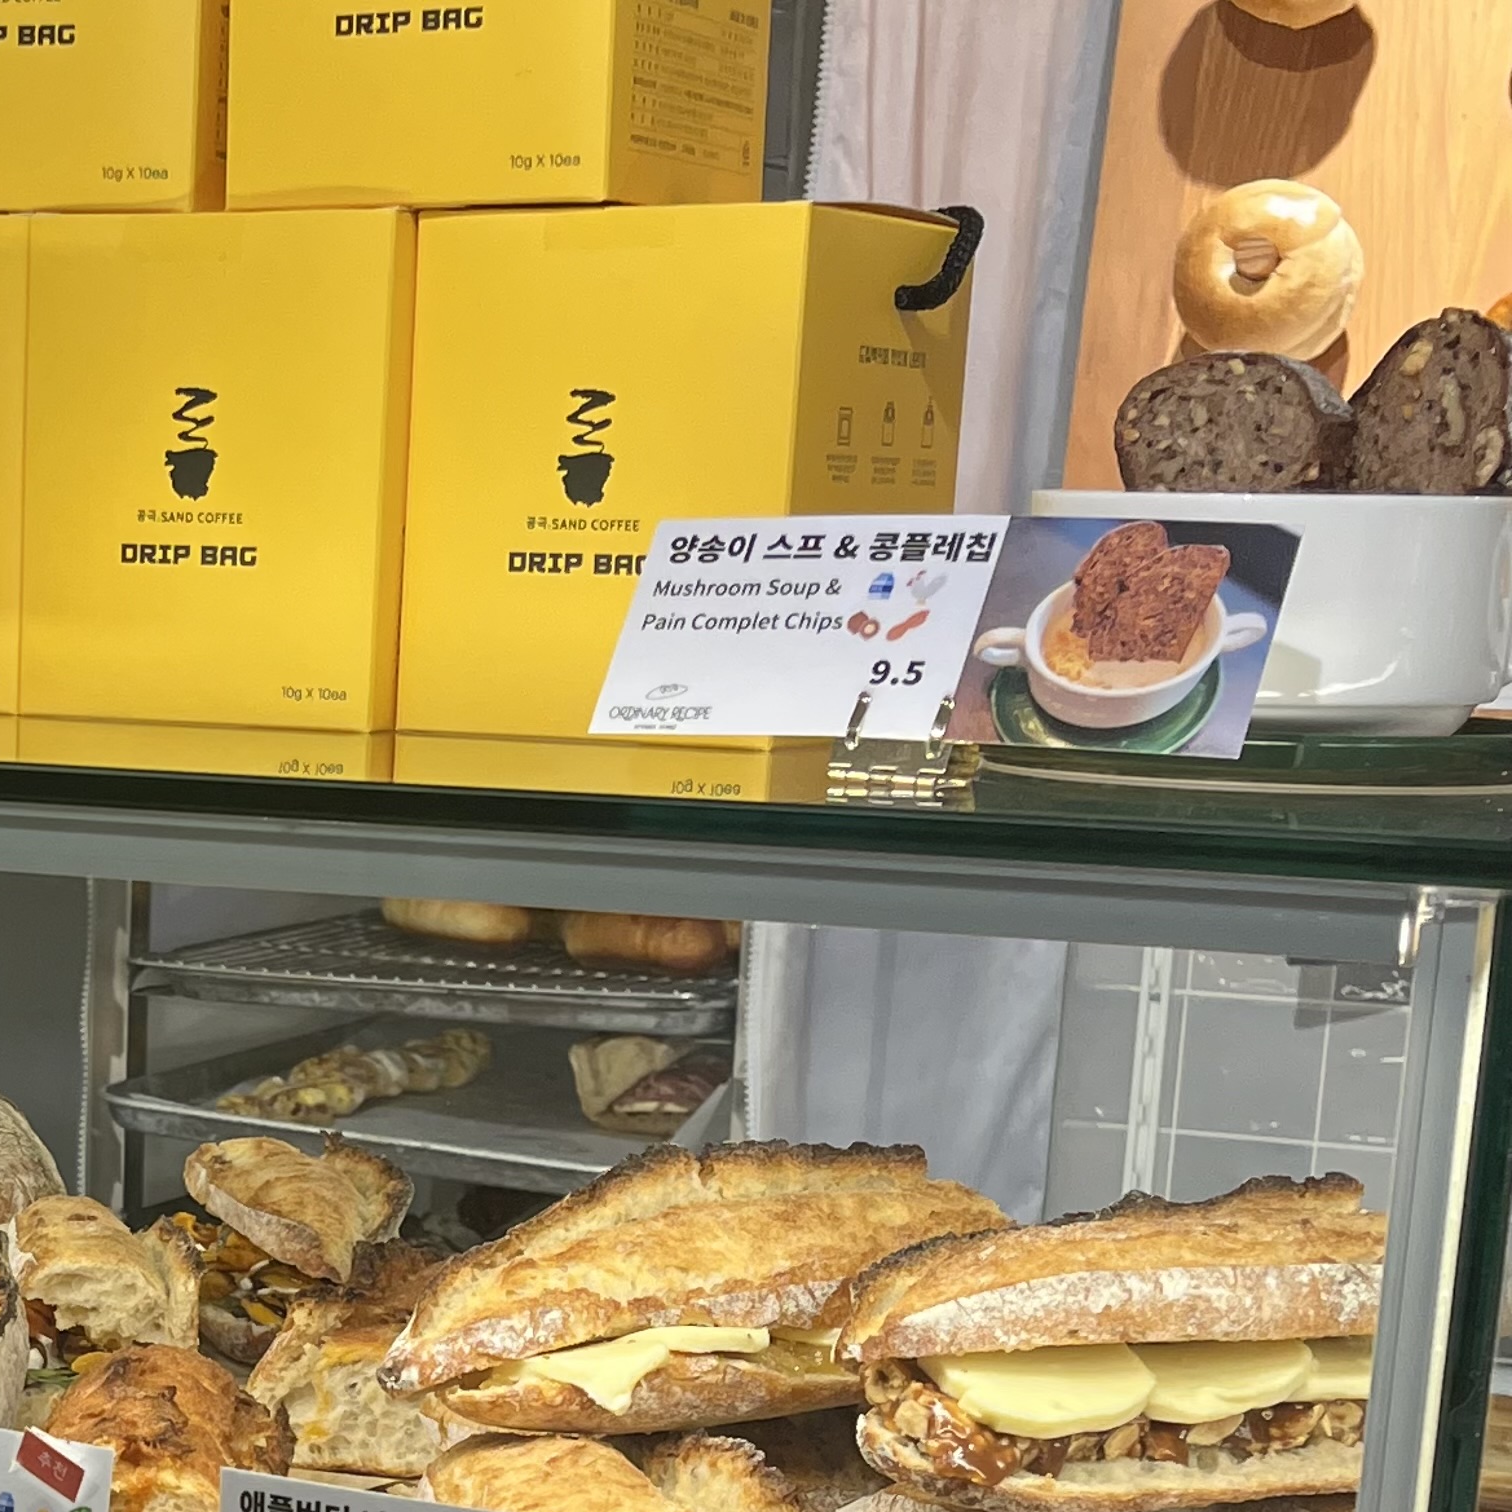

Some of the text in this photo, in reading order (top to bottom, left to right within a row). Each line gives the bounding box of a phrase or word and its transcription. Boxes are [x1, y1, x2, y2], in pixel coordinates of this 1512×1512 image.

[336, 7, 483, 37] DRIP BAG
[18, 25, 75, 46] BAG
[102, 167, 123, 182] 10g
[139, 167, 169, 180] 10ea
[198, 512, 243, 524] COFFEE
[591, 519, 640, 532] COFFEE
[121, 543, 257, 567] DRIP BAG
[669, 532, 997, 564] 양송이 스프 & 콩플레칩
[509, 552, 583, 573] DRIP
[653, 578, 842, 598] Mushroom Soup &
[641, 612, 843, 633] Pain Complet Chips
[869, 660, 925, 685] 9.5
